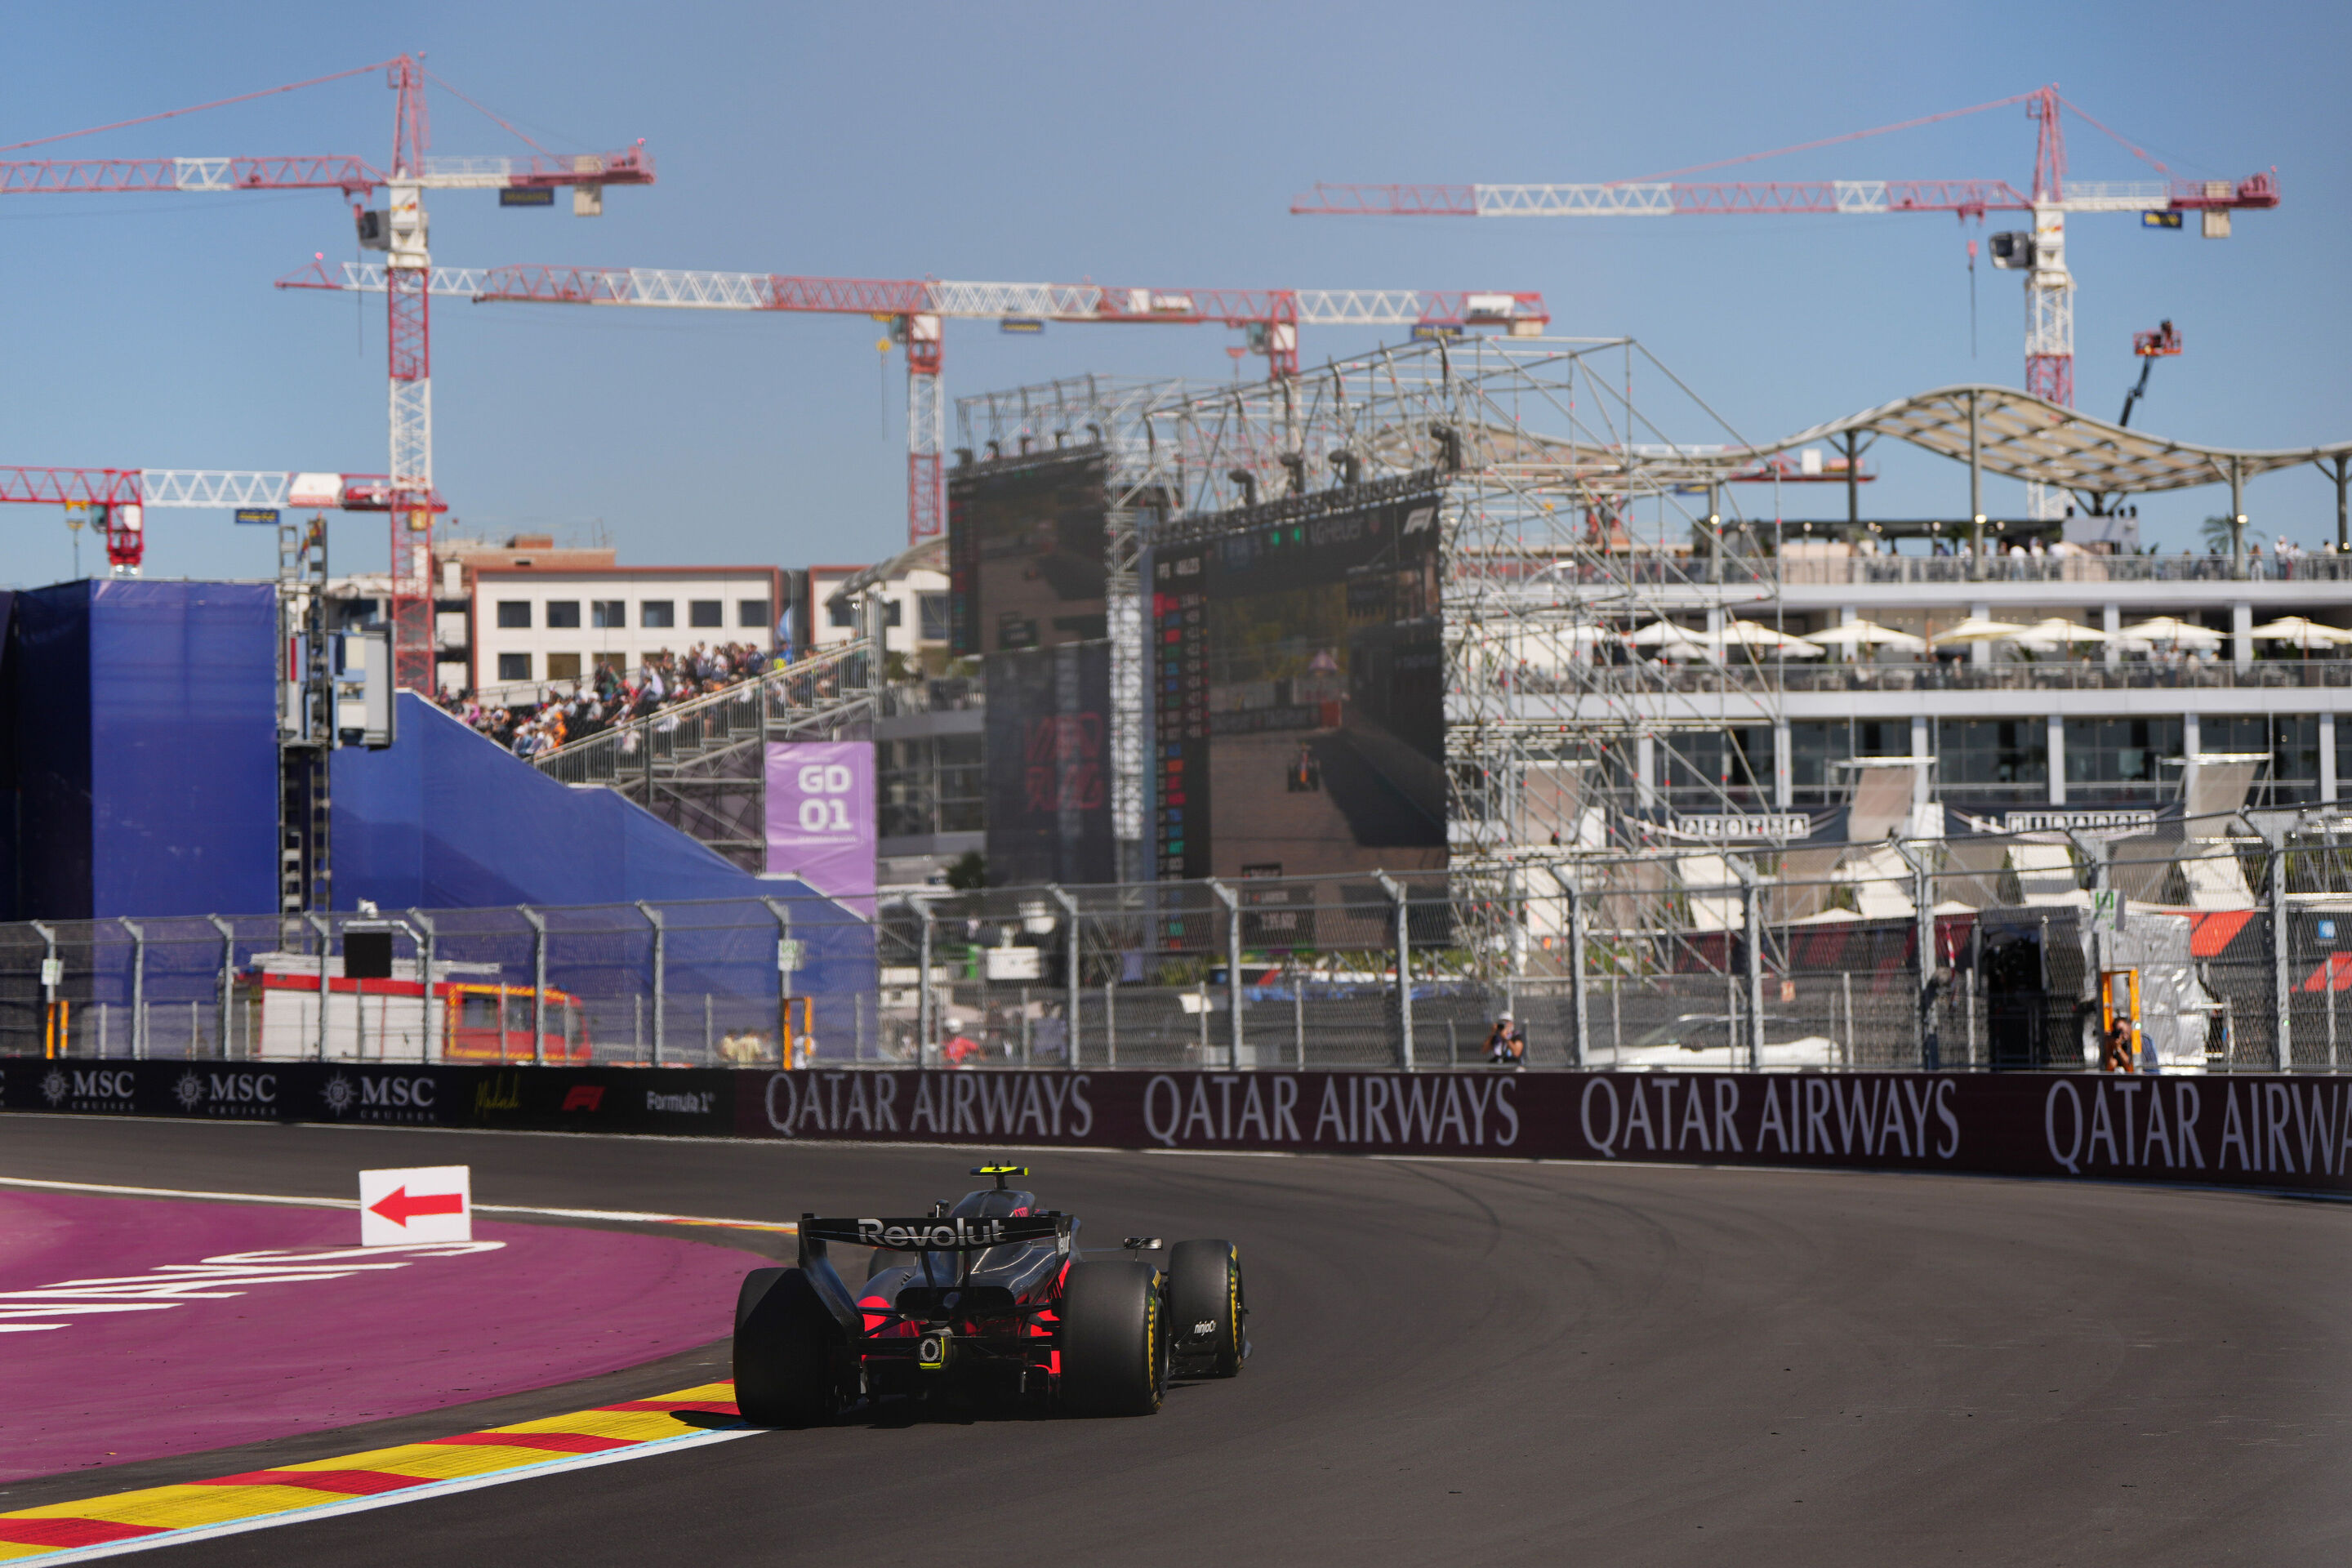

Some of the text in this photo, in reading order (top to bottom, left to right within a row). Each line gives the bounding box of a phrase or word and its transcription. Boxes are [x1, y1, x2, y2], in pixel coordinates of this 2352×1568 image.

[798, 764, 853, 794] GD
[798, 798, 853, 833] 01
[73, 1070, 135, 1098] MSC
[209, 1073, 278, 1103] MSC
[360, 1076, 436, 1107] MSC
[647, 1090, 697, 1112] Formula
[765, 1072, 1093, 1138] QATAR AIRWAYS
[1144, 1074, 1520, 1146] QATAR AIRWAYS
[1580, 1076, 1960, 1159] QATAR AIRWAYS
[2045, 1079, 2206, 1174] QATAR
[858, 1218, 1007, 1247] Revolut
